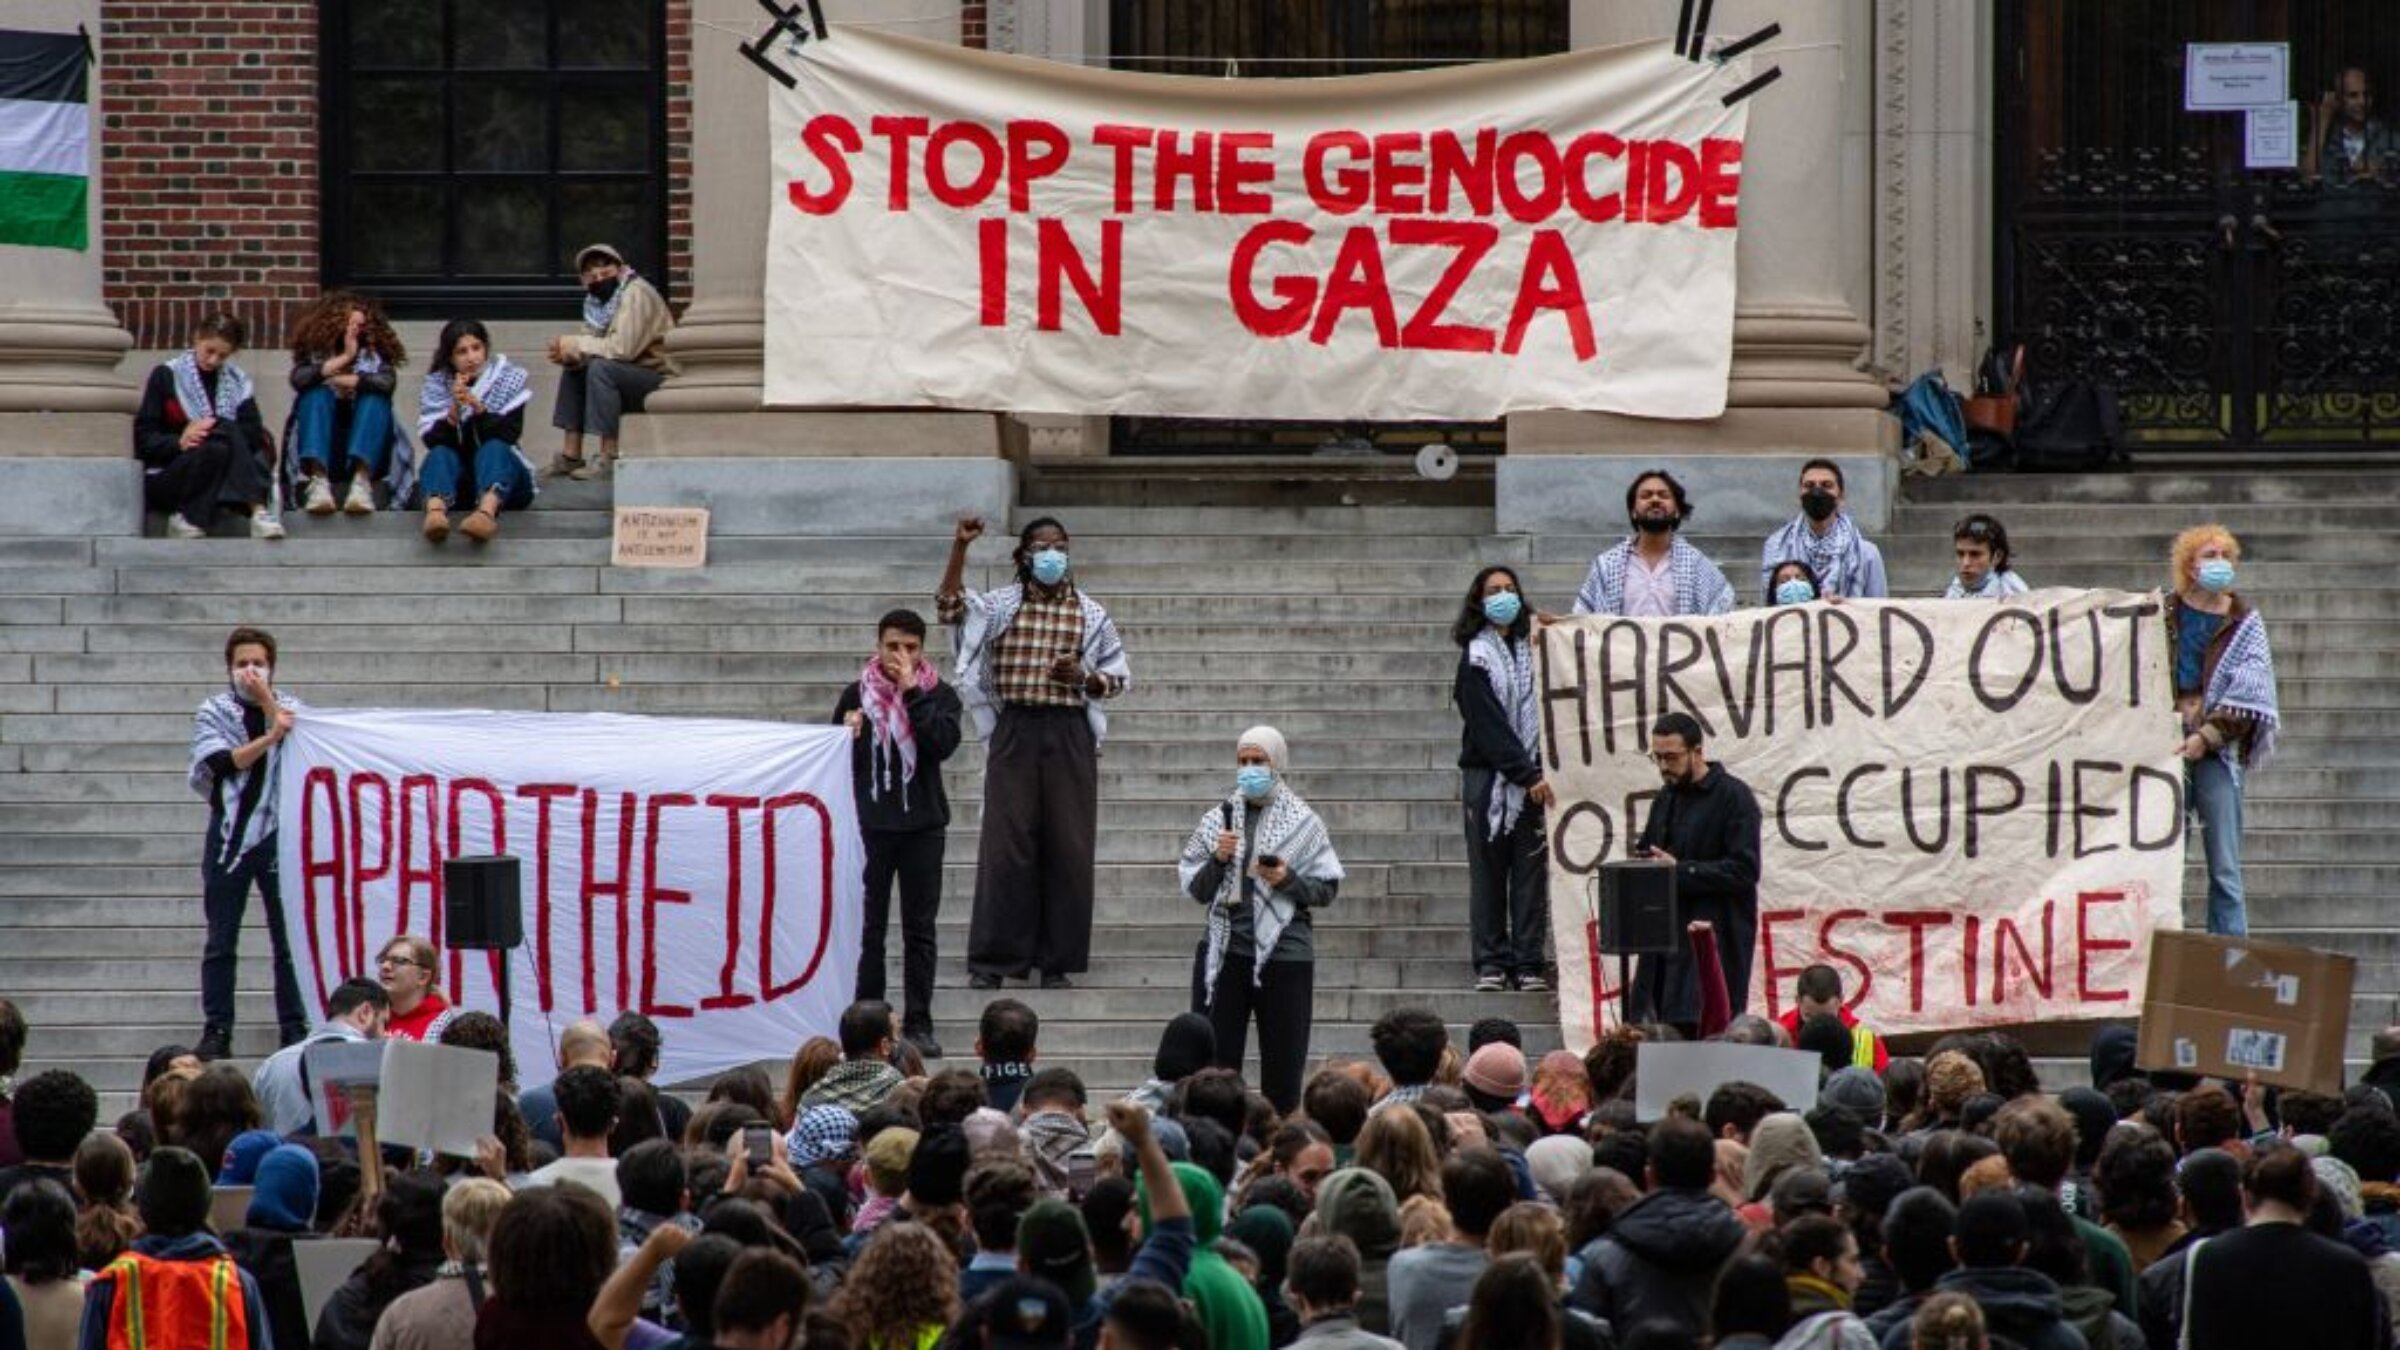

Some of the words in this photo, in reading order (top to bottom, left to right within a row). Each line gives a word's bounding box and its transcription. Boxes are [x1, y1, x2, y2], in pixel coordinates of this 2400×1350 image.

[788, 114, 1070, 214] STOP
[1093, 123, 1276, 214] THE
[1303, 127, 1744, 228] GENOCIDE
[978, 217, 1122, 336] IN
[1228, 217, 1596, 361] GAZA
[1537, 606, 1935, 770] HARVARD
[1968, 603, 2160, 713] OUT
[1776, 759, 2183, 859] CCUPIED
[301, 765, 833, 1017] APARTHEID
[1585, 890, 2134, 1040] PESTINE
